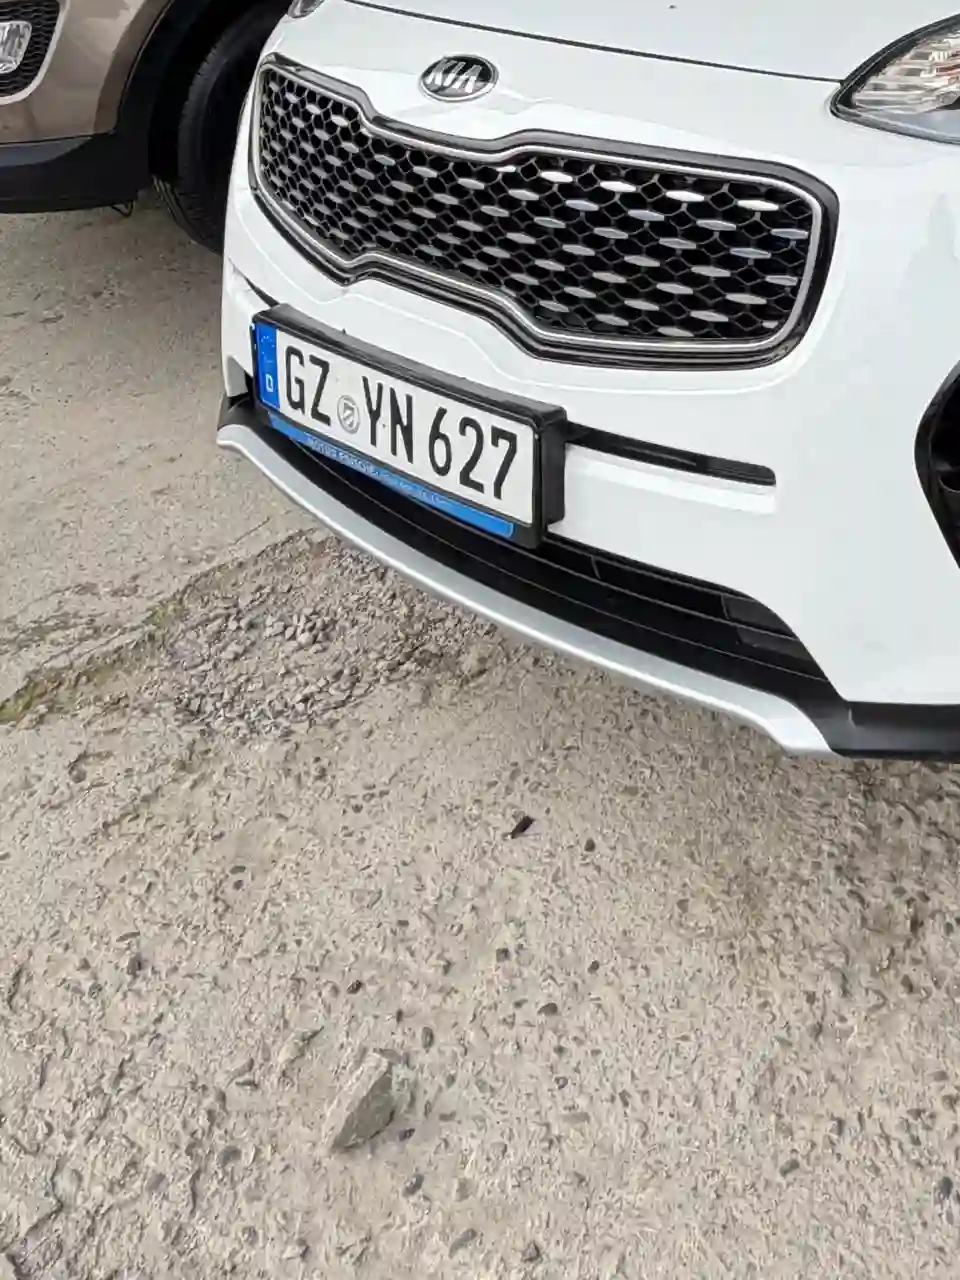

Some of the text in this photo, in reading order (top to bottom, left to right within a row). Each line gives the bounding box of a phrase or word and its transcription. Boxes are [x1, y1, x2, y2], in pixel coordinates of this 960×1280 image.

[424, 58, 483, 94] KIA
[285, 345, 331, 426] GZ
[362, 375, 414, 465] YN
[428, 406, 517, 500] 627
